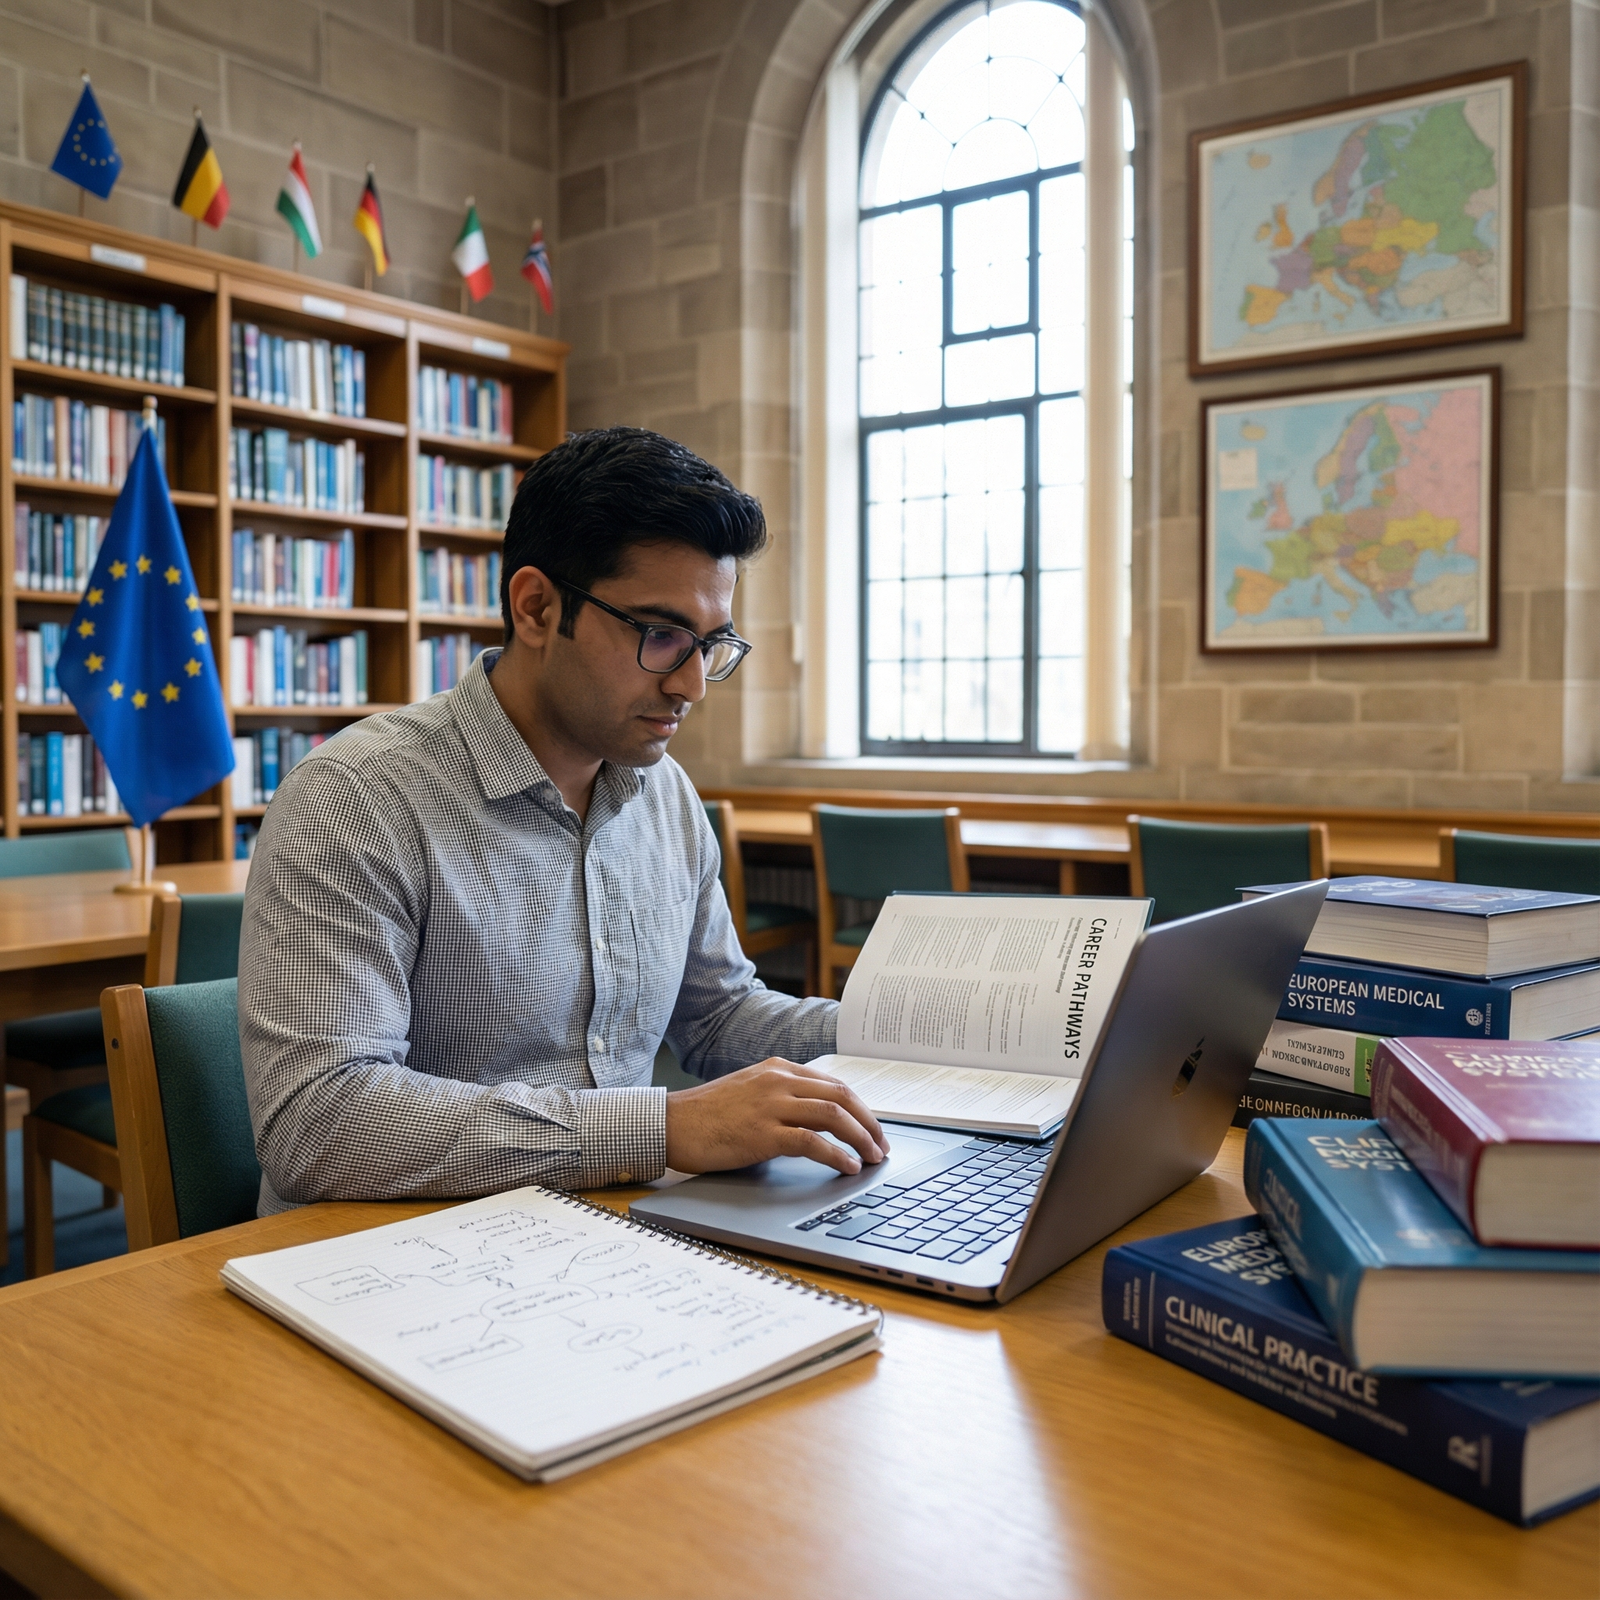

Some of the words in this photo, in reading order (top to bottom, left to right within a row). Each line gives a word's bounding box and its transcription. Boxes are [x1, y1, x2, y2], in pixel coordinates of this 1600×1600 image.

[1078, 917, 1108, 969] CAREER
[1064, 973, 1092, 1060] PATHWAYS
[1287, 991, 1356, 1016] SYSTEMS
[1288, 973, 1369, 999] EUROPEAN
[1373, 984, 1445, 1010] MEDICAL
[1165, 1296, 1260, 1355] CLINICAL
[1264, 1335, 1379, 1407] PRACTICE
